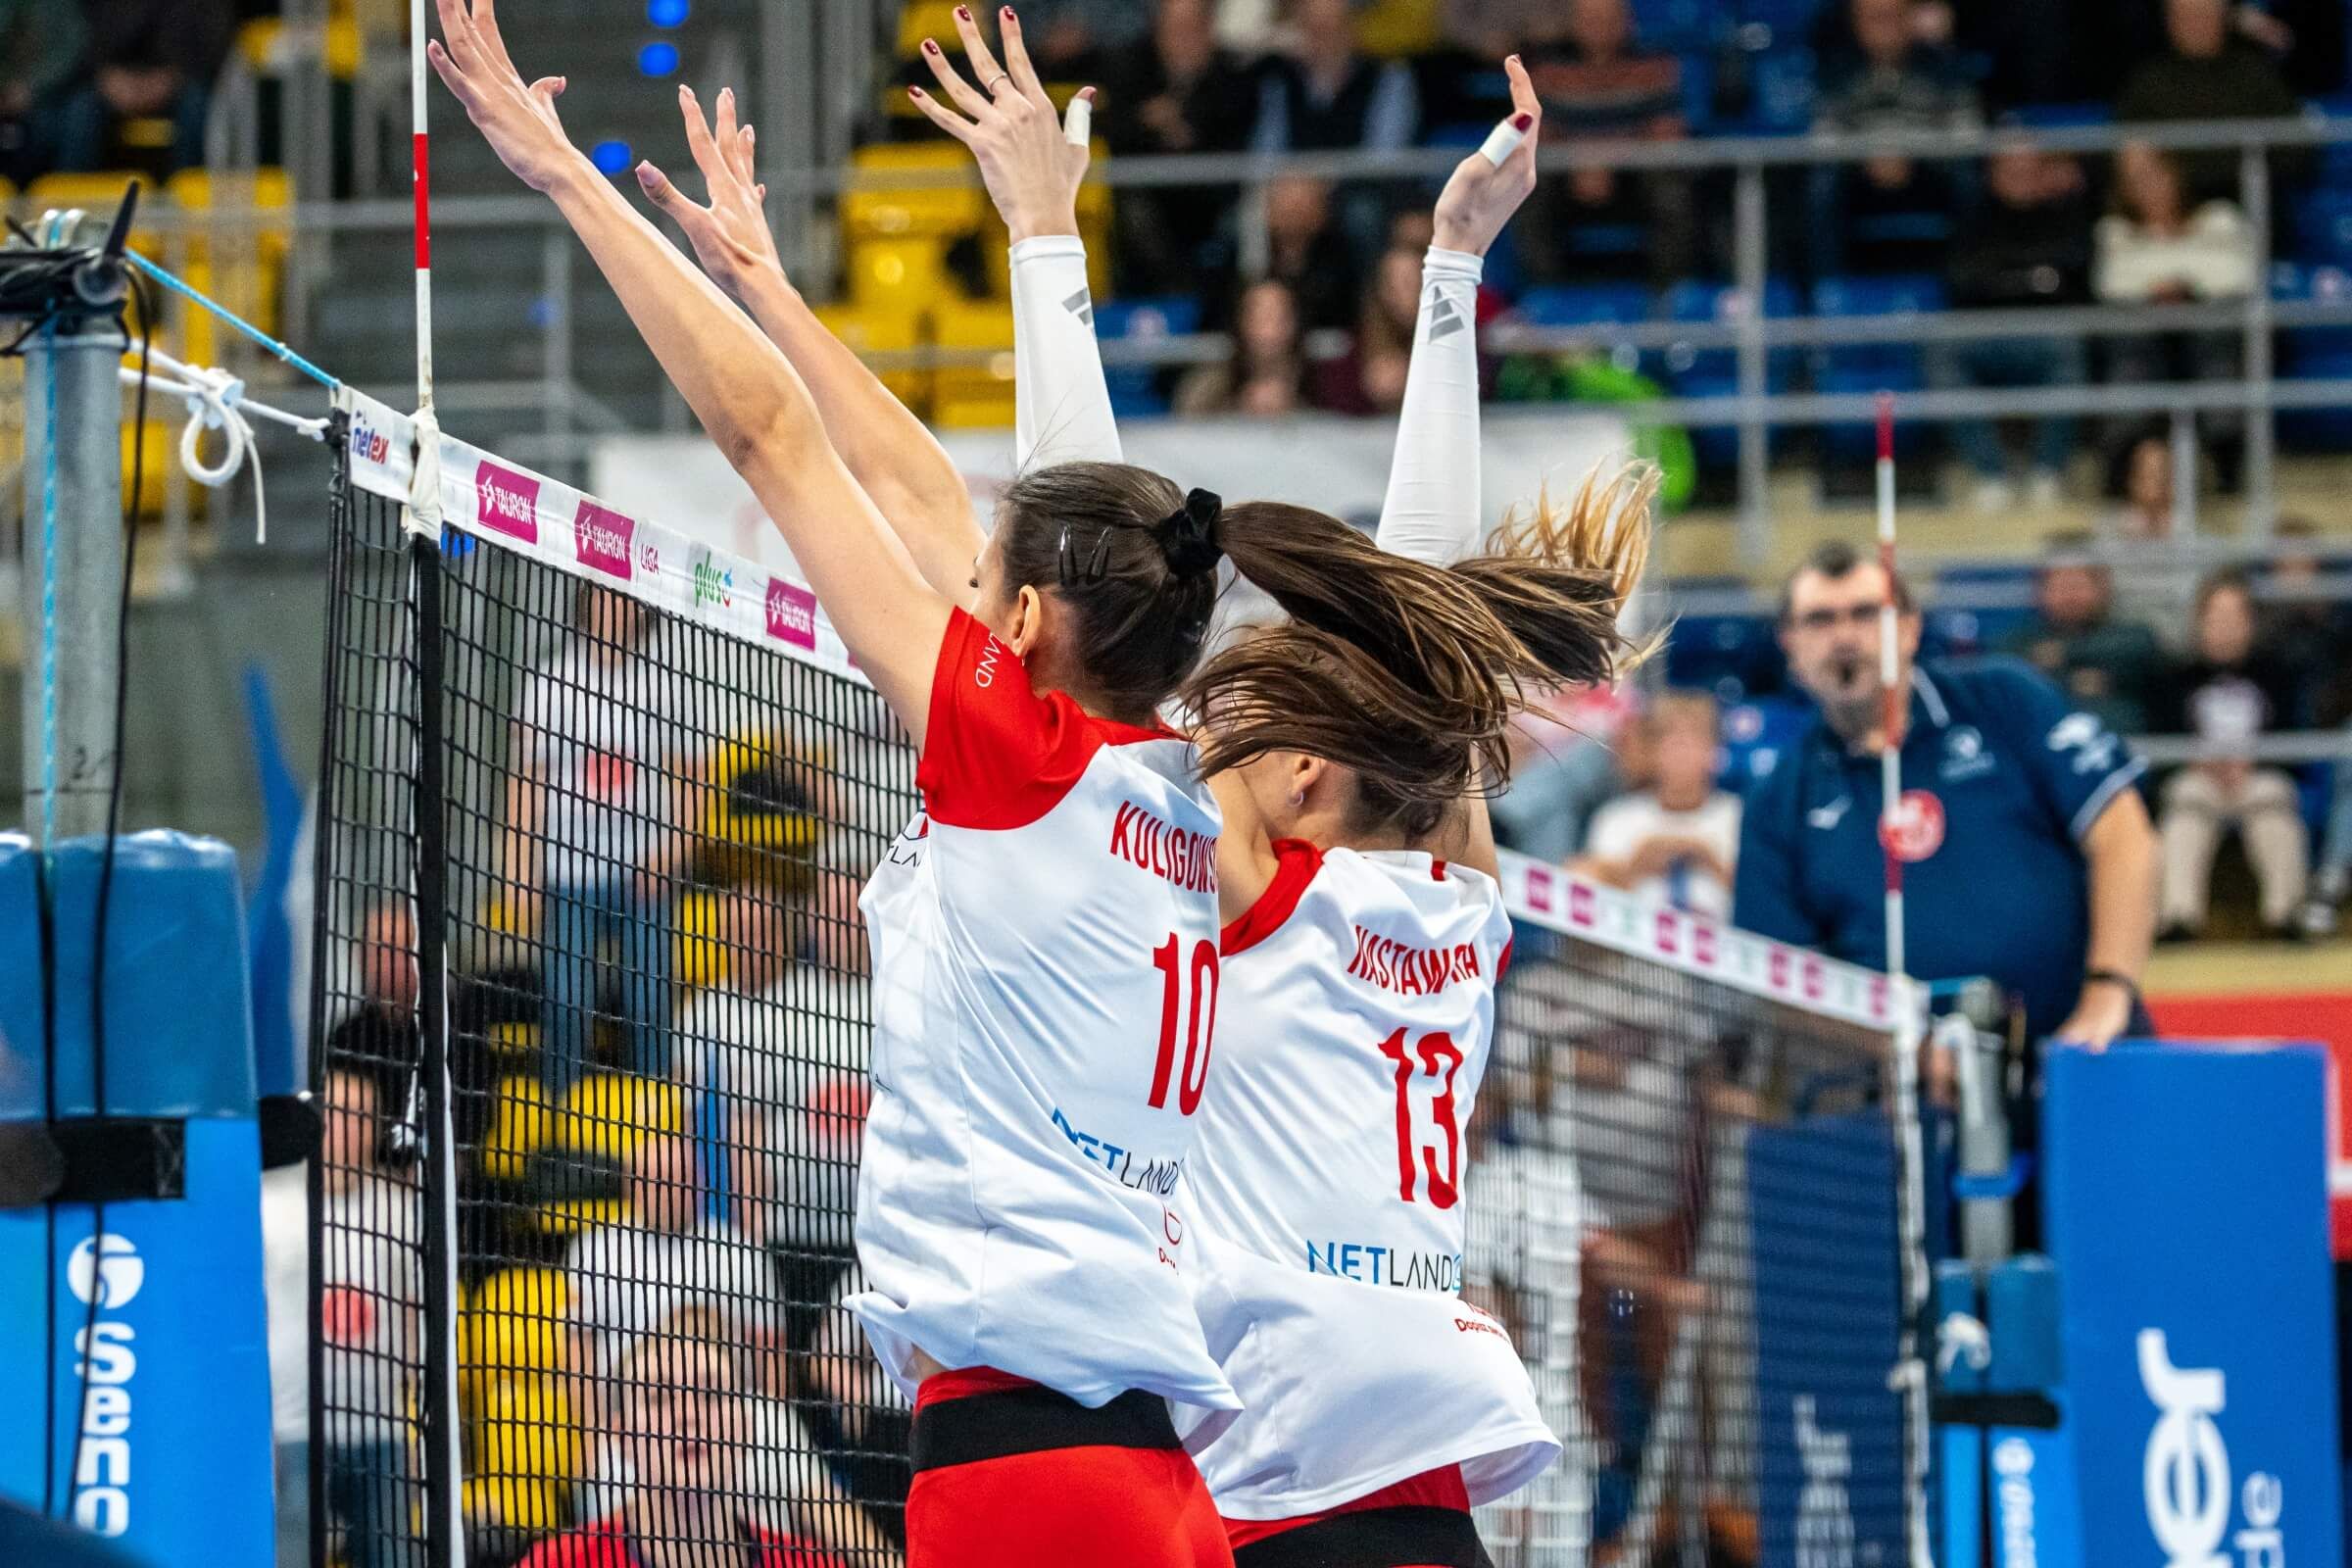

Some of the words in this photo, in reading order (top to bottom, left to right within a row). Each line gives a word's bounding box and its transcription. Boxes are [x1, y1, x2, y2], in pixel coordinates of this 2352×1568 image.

[352, 426, 390, 466] netex
[494, 486, 532, 526] TAURON
[591, 524, 627, 564] TAURON
[640, 542, 660, 576] LIGA
[694, 550, 723, 609] plus
[1147, 932, 1220, 1116] 10
[1378, 1027, 1464, 1210] 13
[1306, 1239, 1453, 1293] NETLAND
